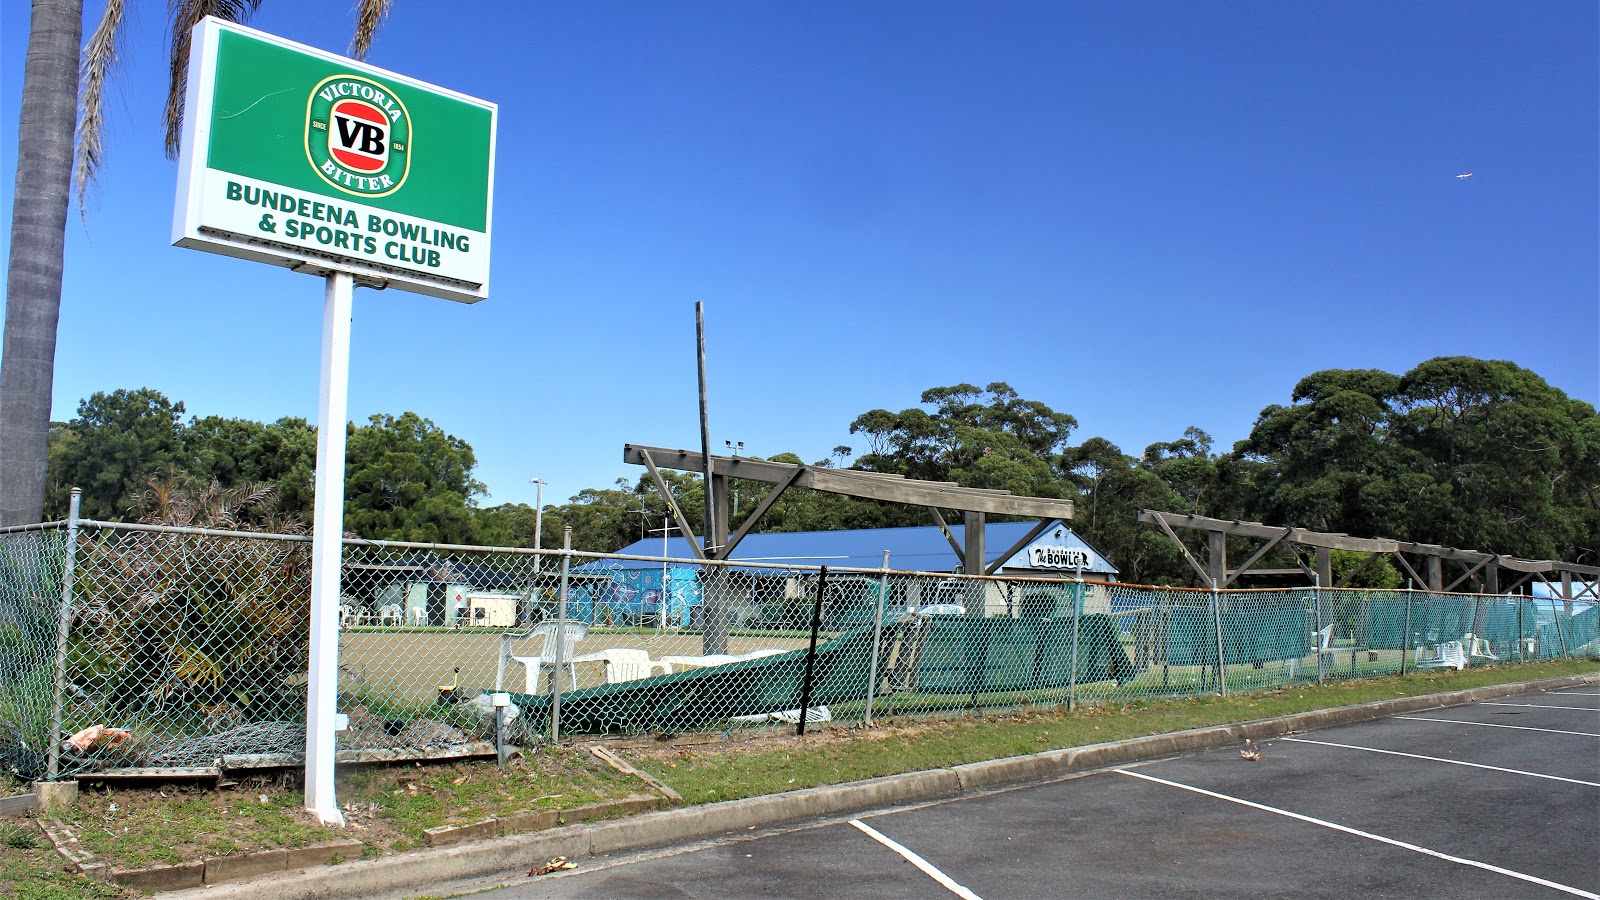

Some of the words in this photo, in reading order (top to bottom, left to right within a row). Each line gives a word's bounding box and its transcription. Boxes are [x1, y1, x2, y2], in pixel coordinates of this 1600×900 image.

[319, 82, 402, 124] VICTORIA
[312, 120, 327, 131] SINCE
[334, 115, 385, 156] VB
[393, 142, 405, 152] 1854
[320, 158, 395, 191] BITTER
[226, 181, 359, 230] BUNDEENA
[367, 214, 470, 253] BOWLING
[258, 213, 277, 234] &
[284, 219, 377, 255] SPORTS
[384, 241, 441, 268] CLUB
